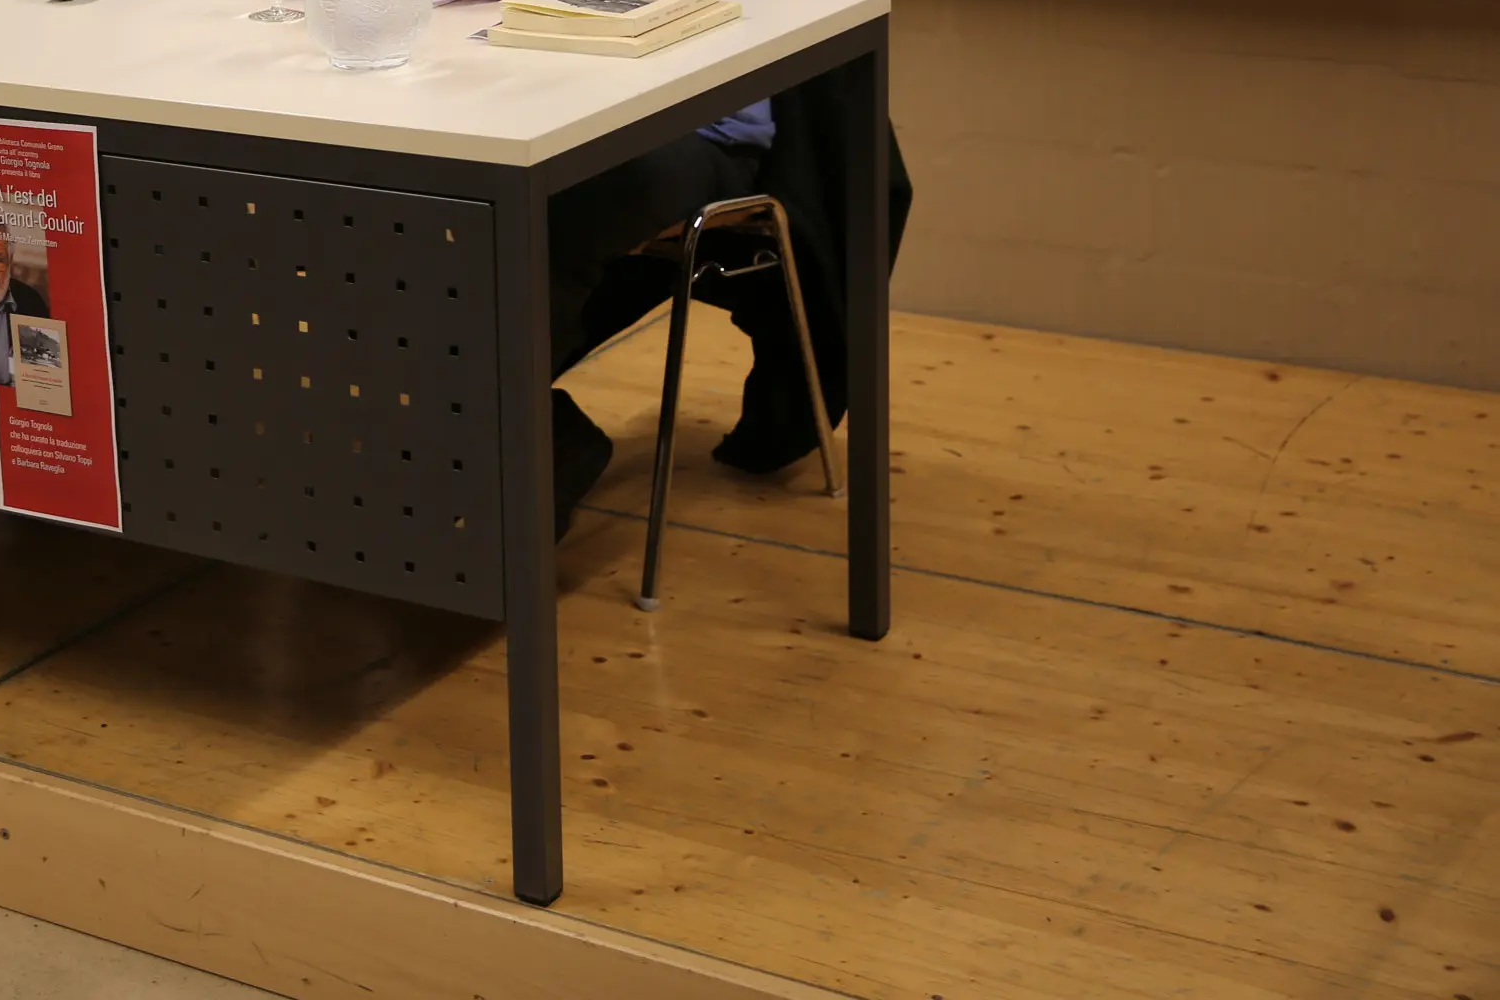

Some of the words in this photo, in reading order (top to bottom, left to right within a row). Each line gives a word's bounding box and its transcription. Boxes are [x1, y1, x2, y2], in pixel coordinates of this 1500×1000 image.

[20, 140, 46, 149] Comunale
[0, 156, 23, 167] Giorgio
[24, 158, 50, 170] Tognola
[6, 186, 34, 205] l'est
[36, 189, 57, 208] del
[9, 416, 30, 428] Giorgio
[30, 420, 53, 432] Tognola
[10, 430, 21, 439] che
[21, 433, 29, 441] ha
[49, 437, 55, 445] la
[16, 457, 39, 469] Barbara
[43, 450, 54, 458] con
[54, 451, 76, 462] Silvano
[77, 455, 92, 466] Toppi
